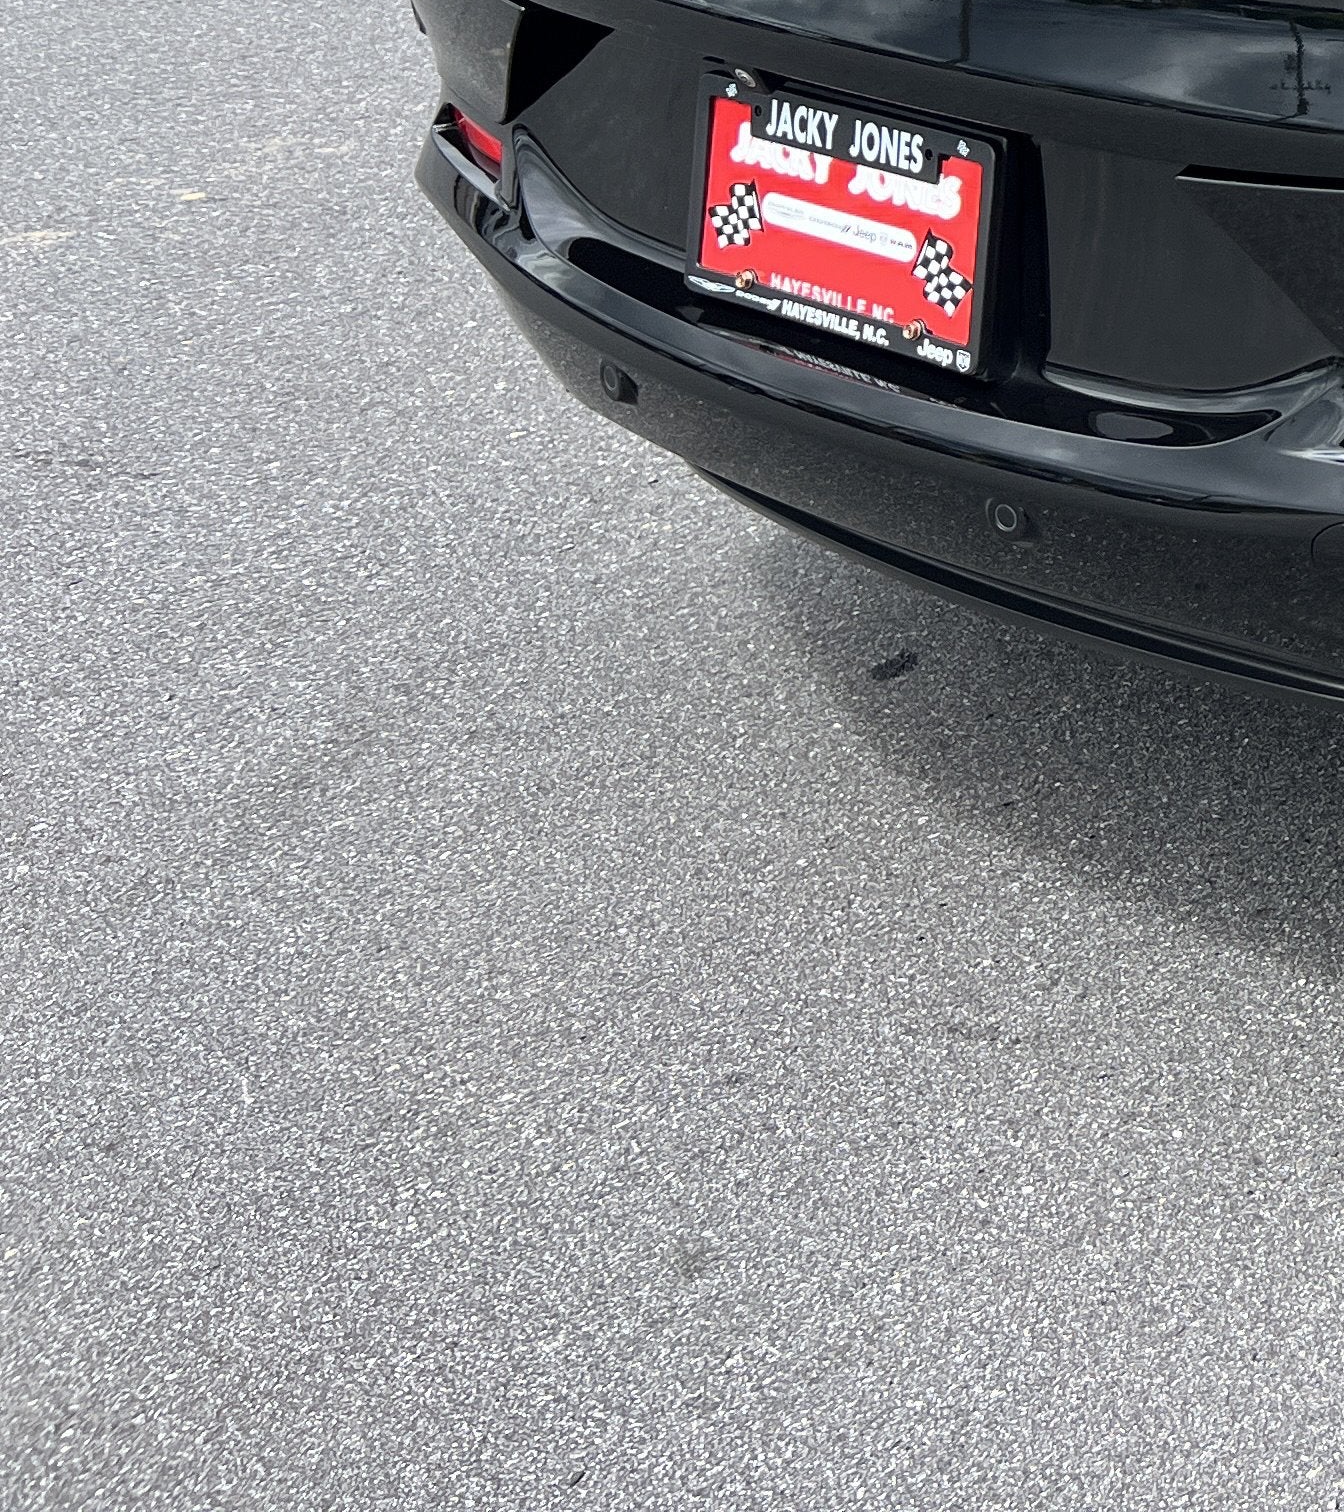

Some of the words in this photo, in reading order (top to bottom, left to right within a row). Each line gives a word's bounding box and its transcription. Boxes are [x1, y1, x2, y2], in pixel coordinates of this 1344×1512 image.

[766, 99, 839, 150] JACKY
[849, 120, 924, 173] JONES
[770, 272, 867, 314] HAYESVILLE
[781, 299, 861, 340] HAYESVILLE,
[916, 337, 954, 367] Jeep
